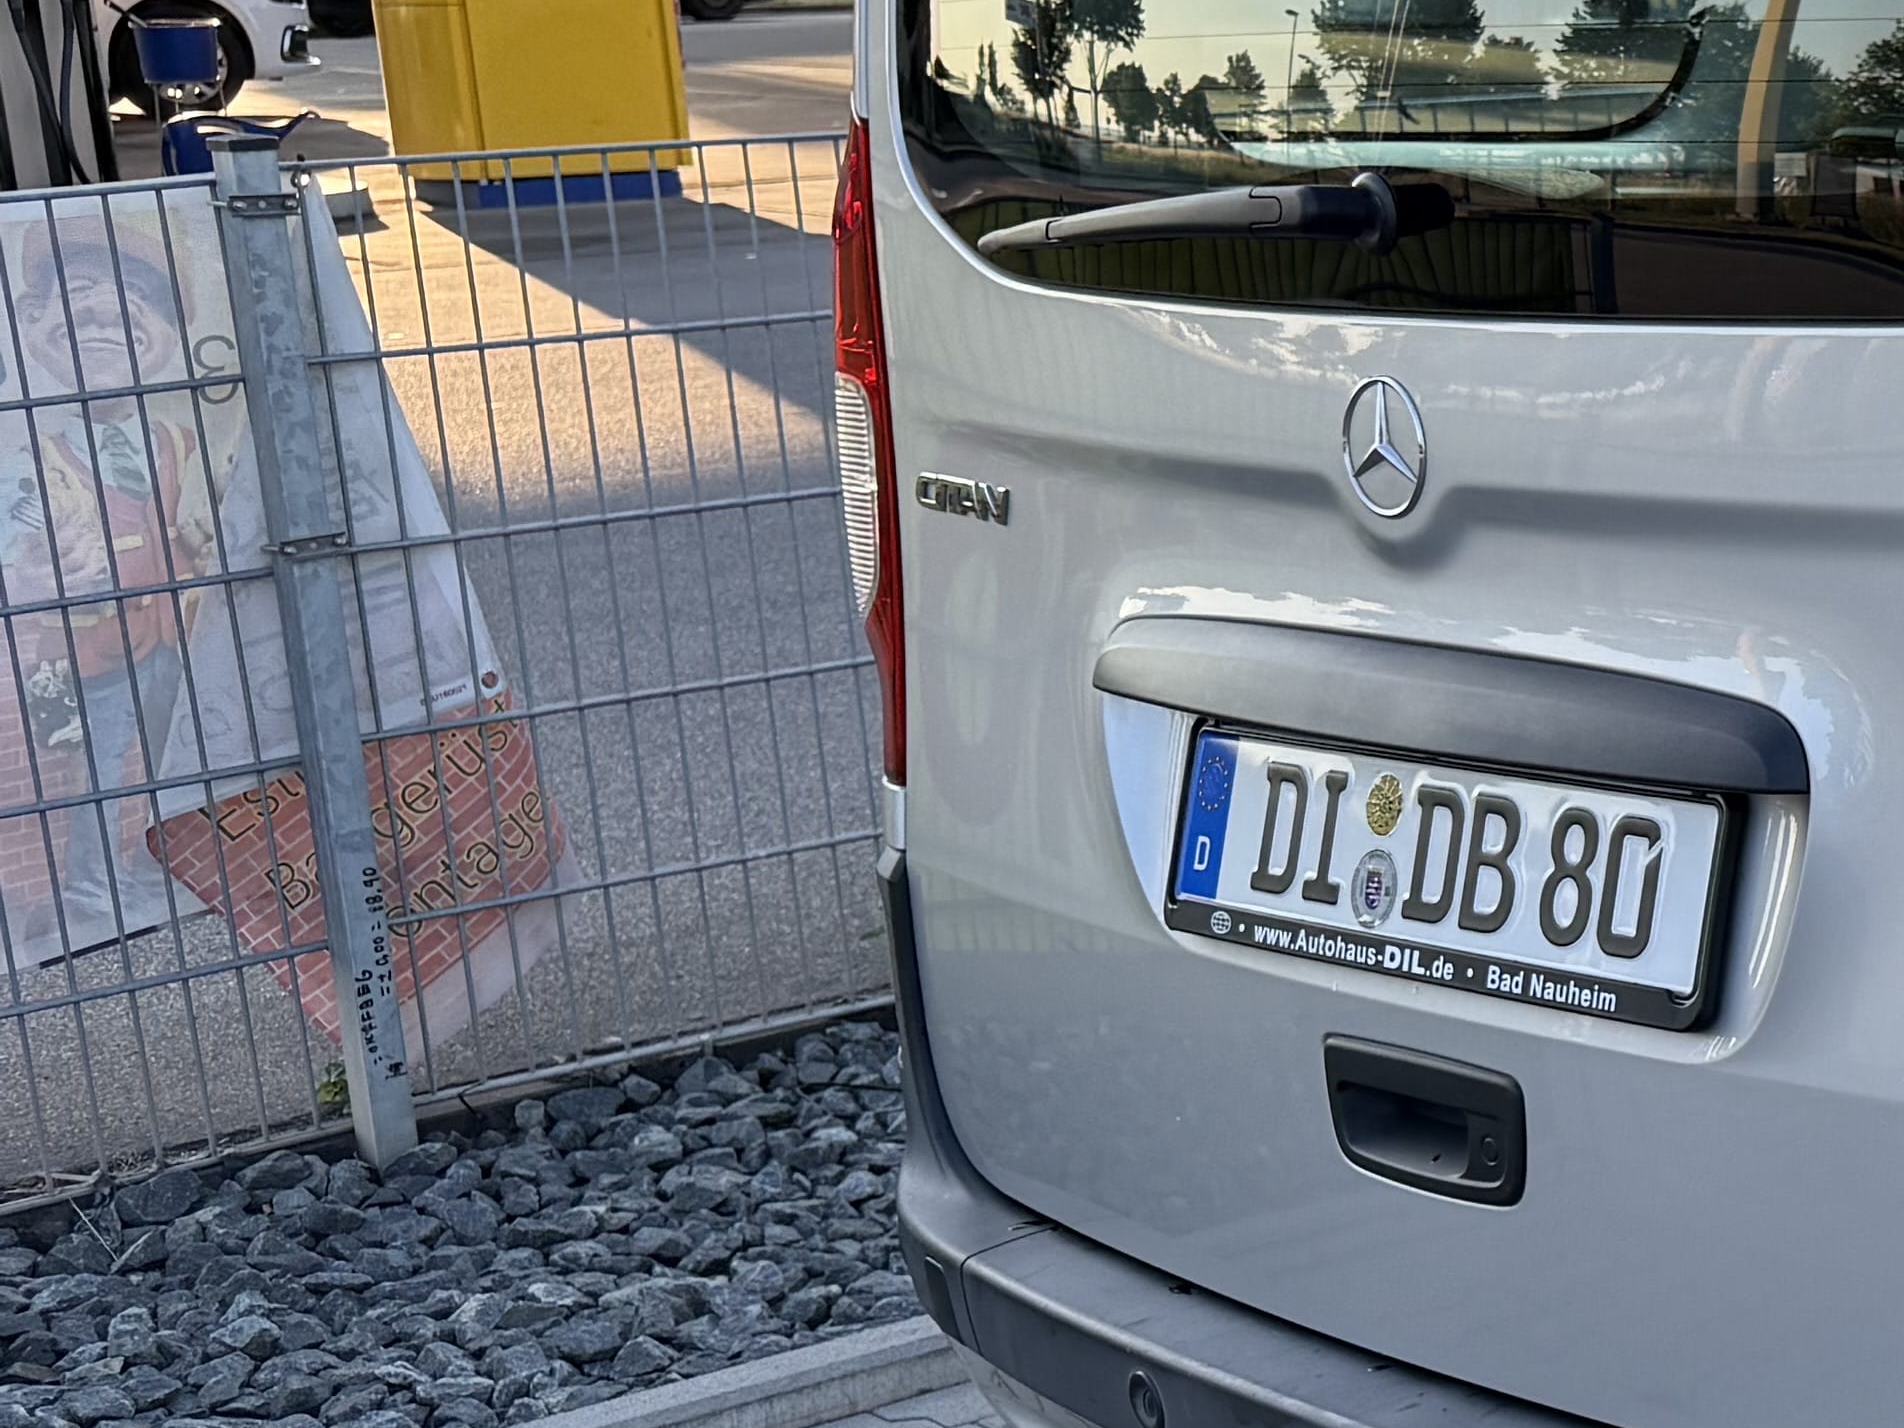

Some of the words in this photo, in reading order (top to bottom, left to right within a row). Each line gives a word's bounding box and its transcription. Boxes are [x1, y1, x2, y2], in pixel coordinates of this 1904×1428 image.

[1193, 836, 1211, 871] D
[1249, 760, 1349, 906] DI
[1400, 783, 1522, 934] DB
[1539, 806, 1664, 959] 80
[1253, 923, 1455, 982] www.Autohaus-DIL.de
[1486, 964, 1525, 994] Bad
[1529, 972, 1617, 1013] Nauheim
